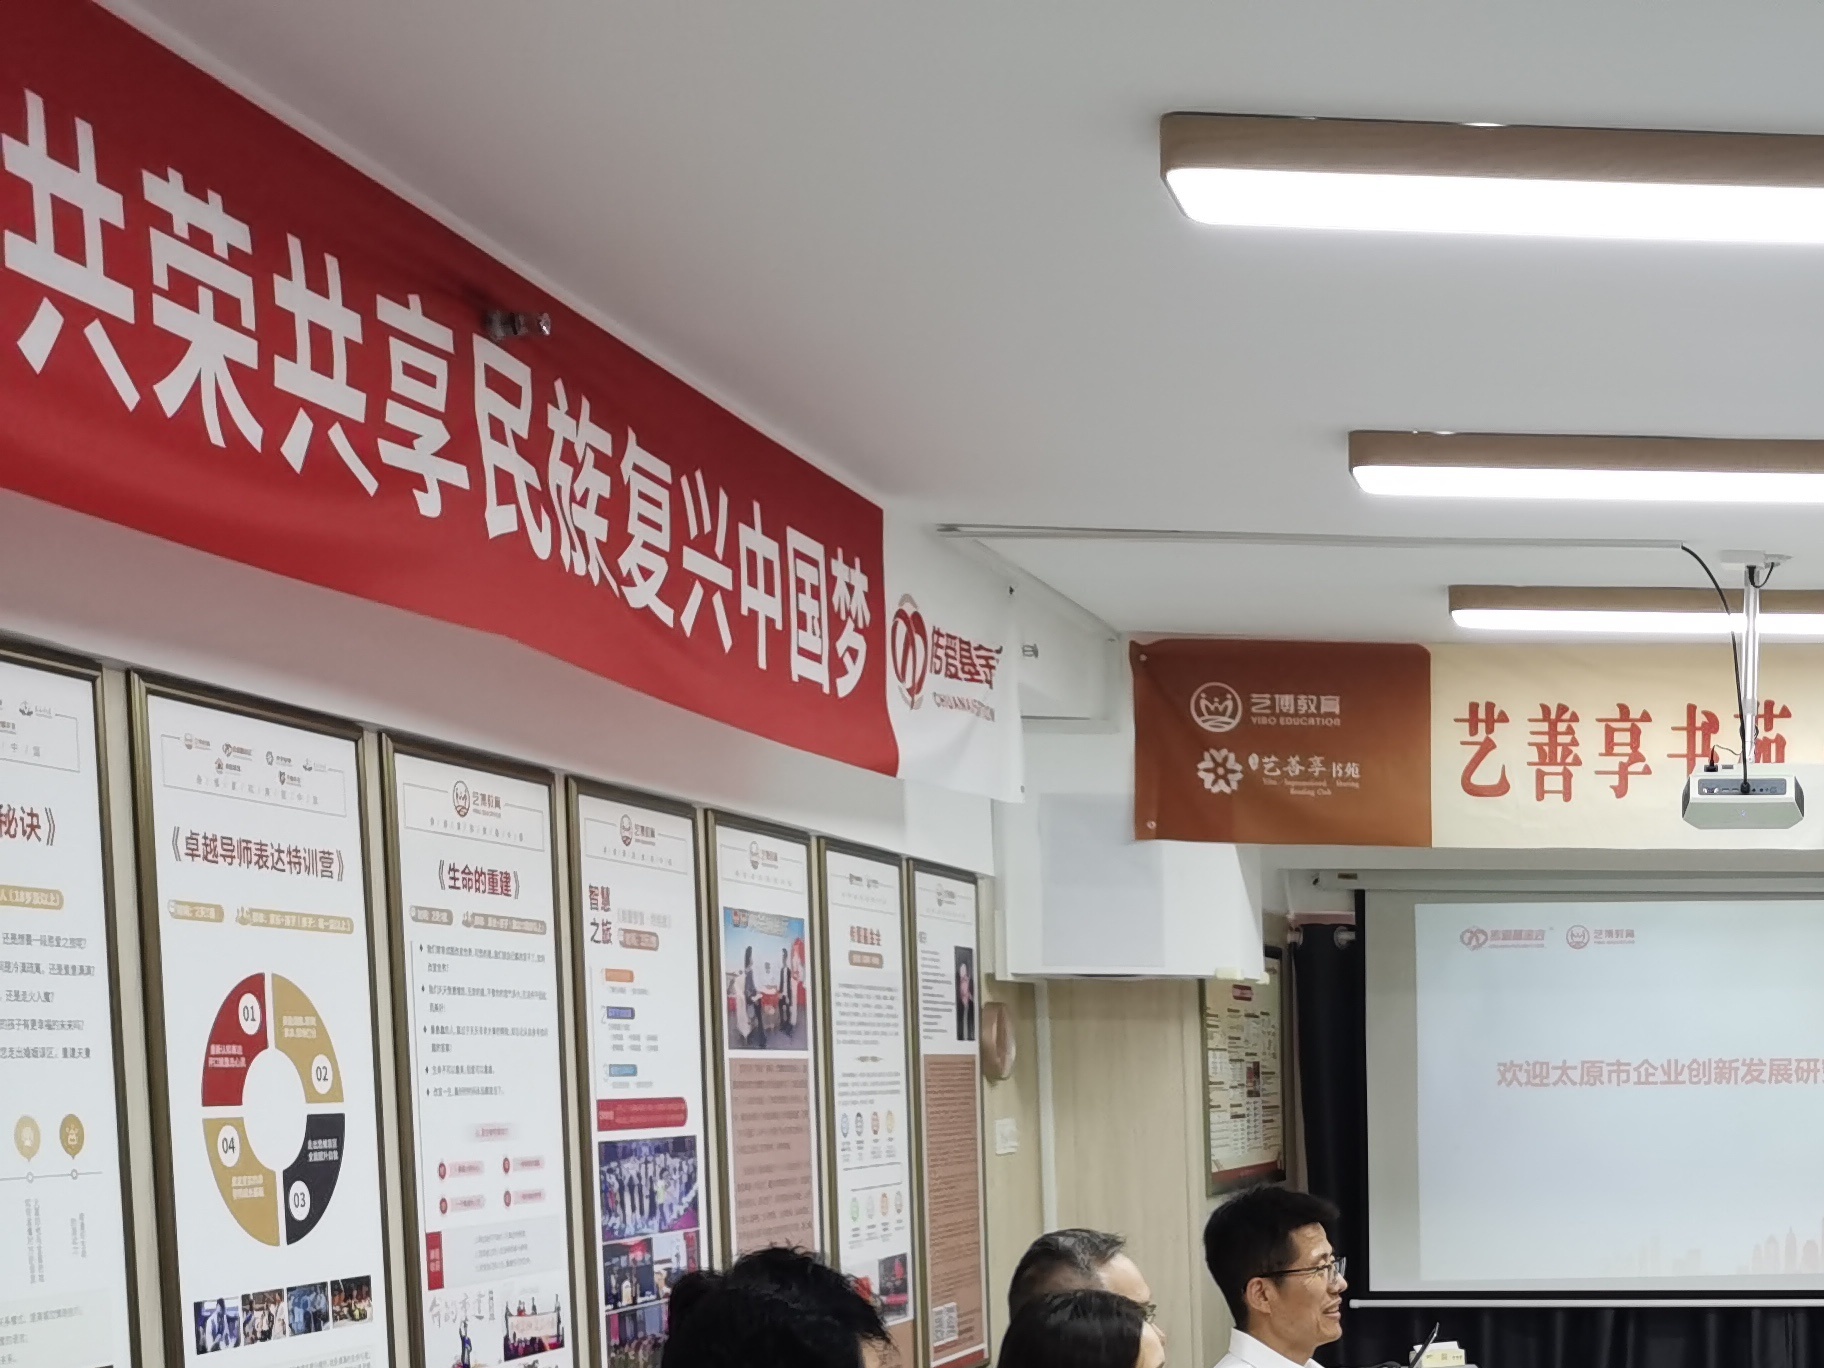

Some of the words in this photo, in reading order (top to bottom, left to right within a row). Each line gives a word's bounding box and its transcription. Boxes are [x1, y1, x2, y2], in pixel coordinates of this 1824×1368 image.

[2, 88, 870, 698] 共荣共享民族复兴中国梦
[1250, 693, 1341, 715] 艺博教育
[172, 825, 344, 882] 《卓越导师表达特训营》
[438, 859, 520, 900] 《生命的重建》
[242, 1005, 257, 1022] 01
[315, 1065, 329, 1082] 02
[221, 1136, 236, 1154] 04
[293, 1192, 306, 1208] 03
